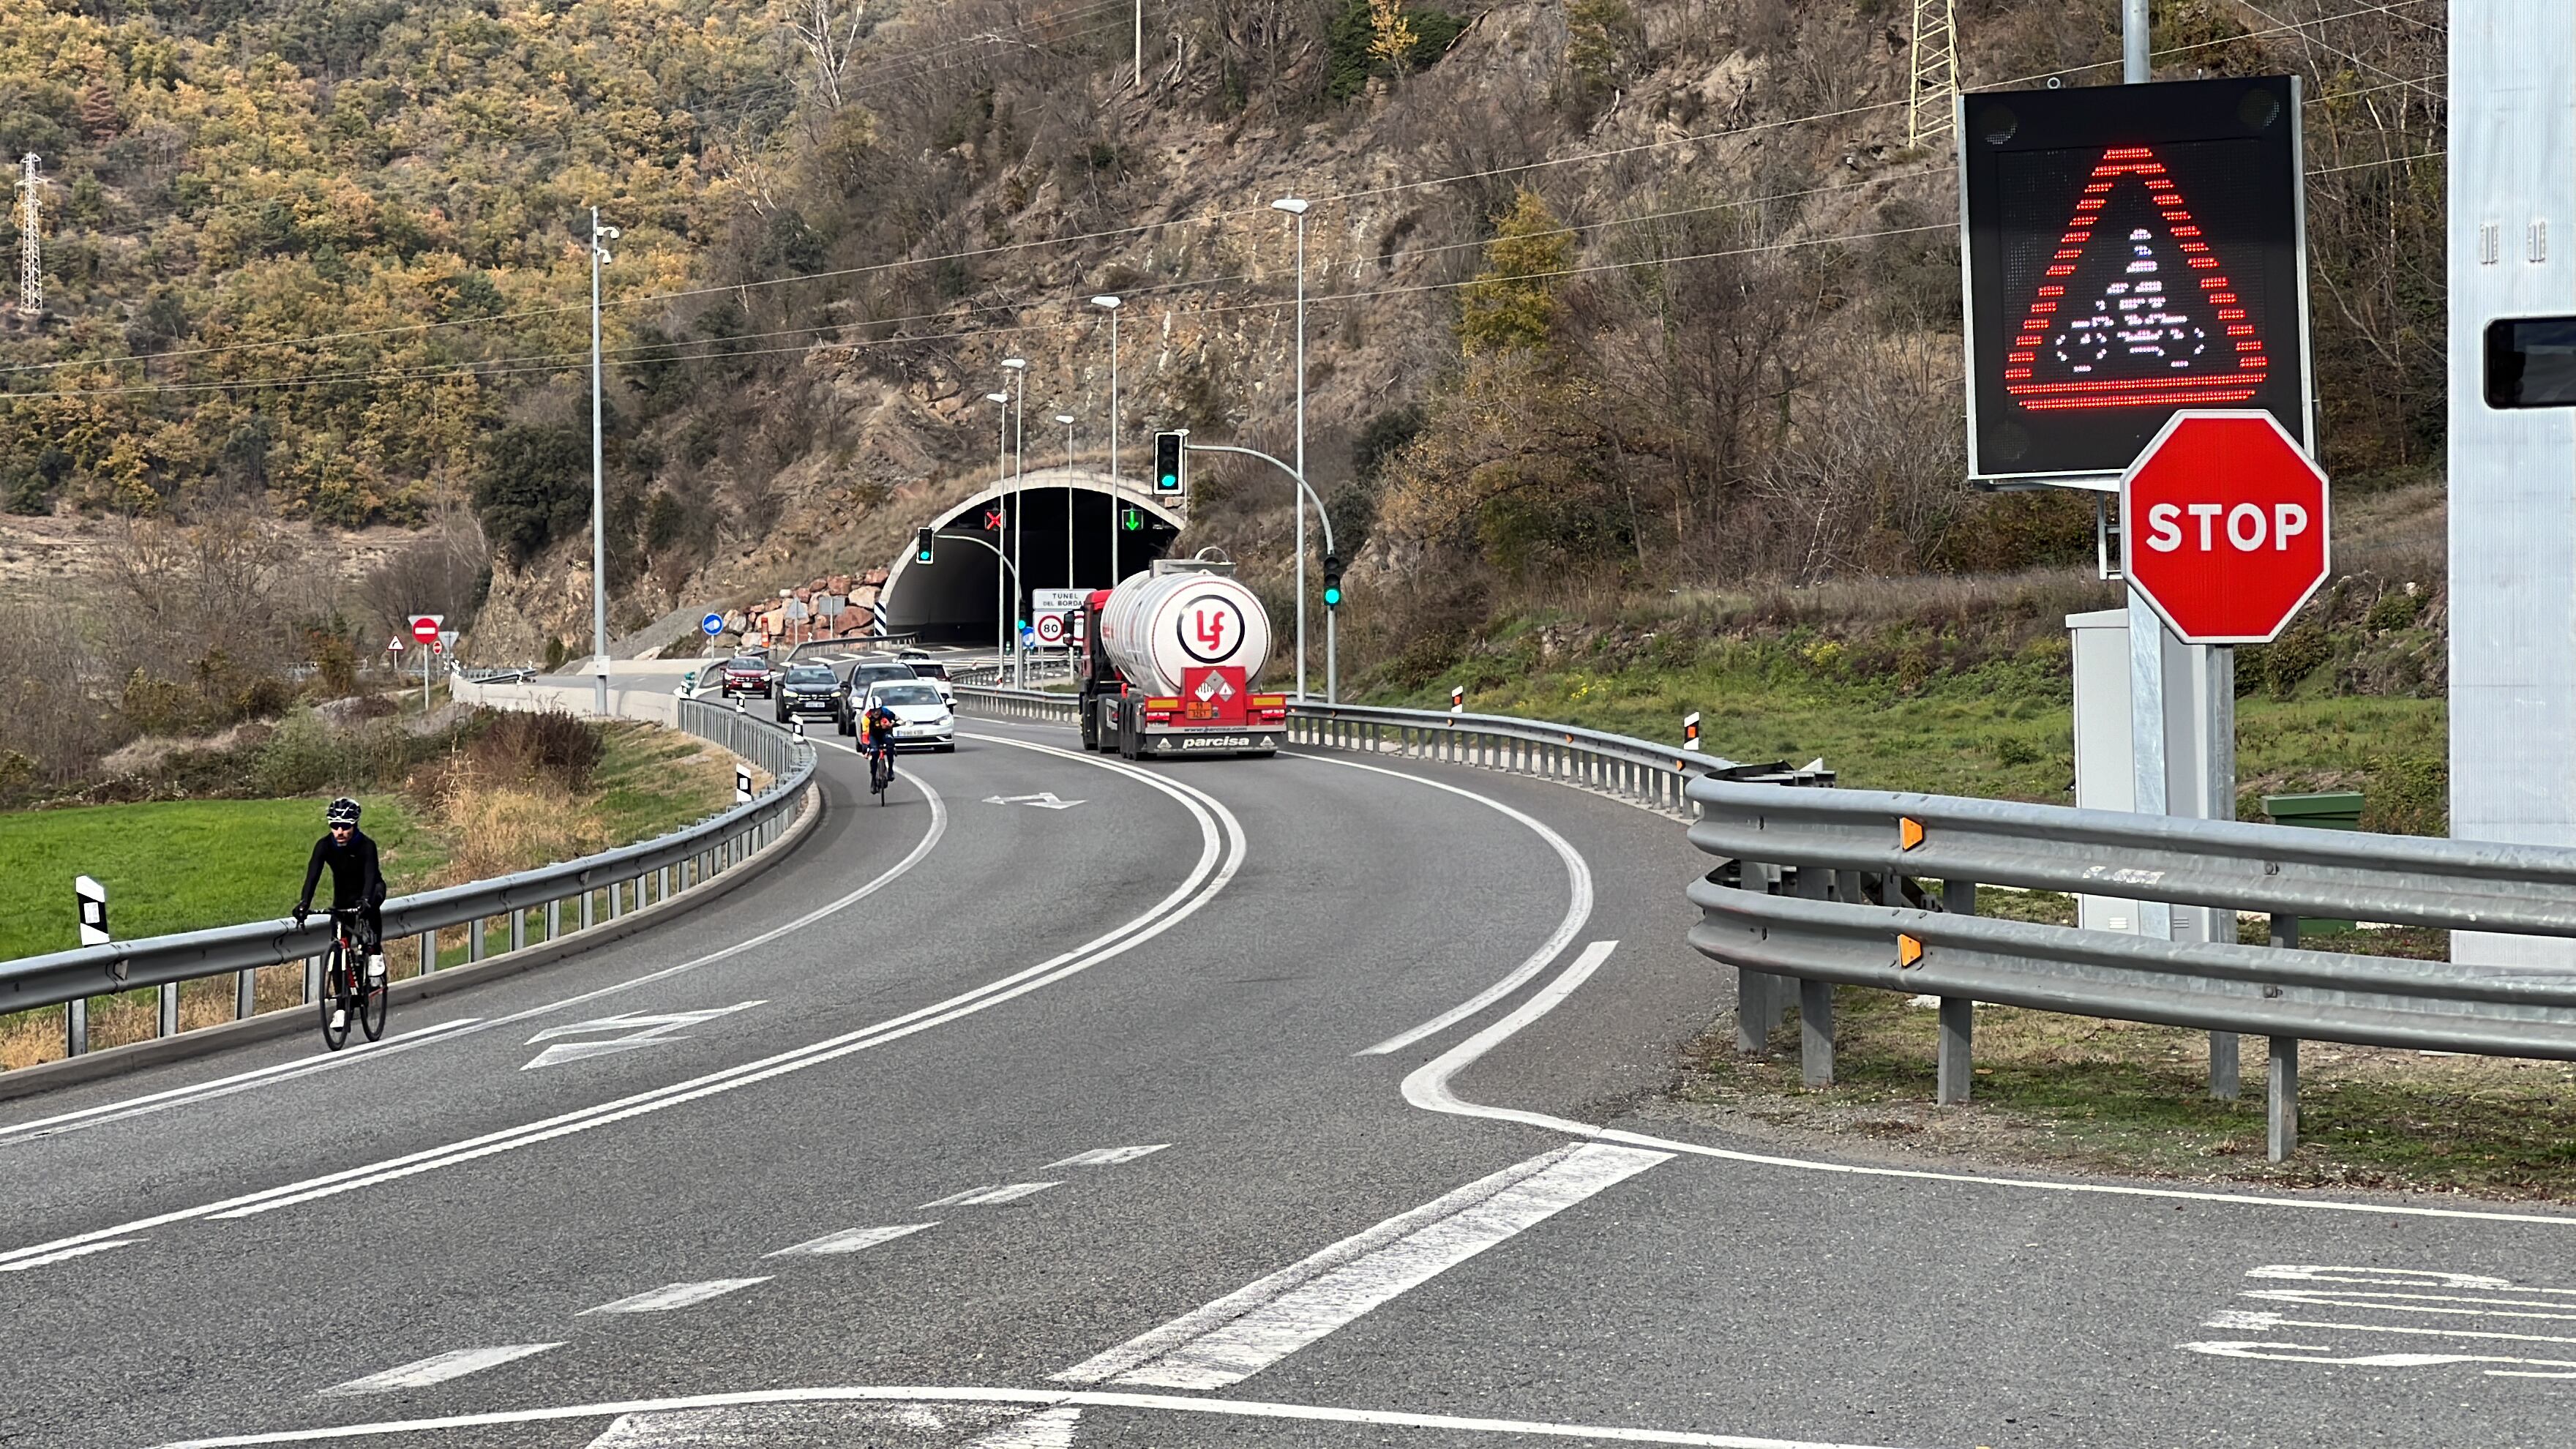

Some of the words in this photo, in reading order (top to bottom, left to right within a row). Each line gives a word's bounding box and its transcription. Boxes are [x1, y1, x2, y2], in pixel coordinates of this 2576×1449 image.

[2146, 502, 2308, 553] STOP
[1044, 624, 1058, 633] 80
[1182, 735, 1250, 749] parcisa
